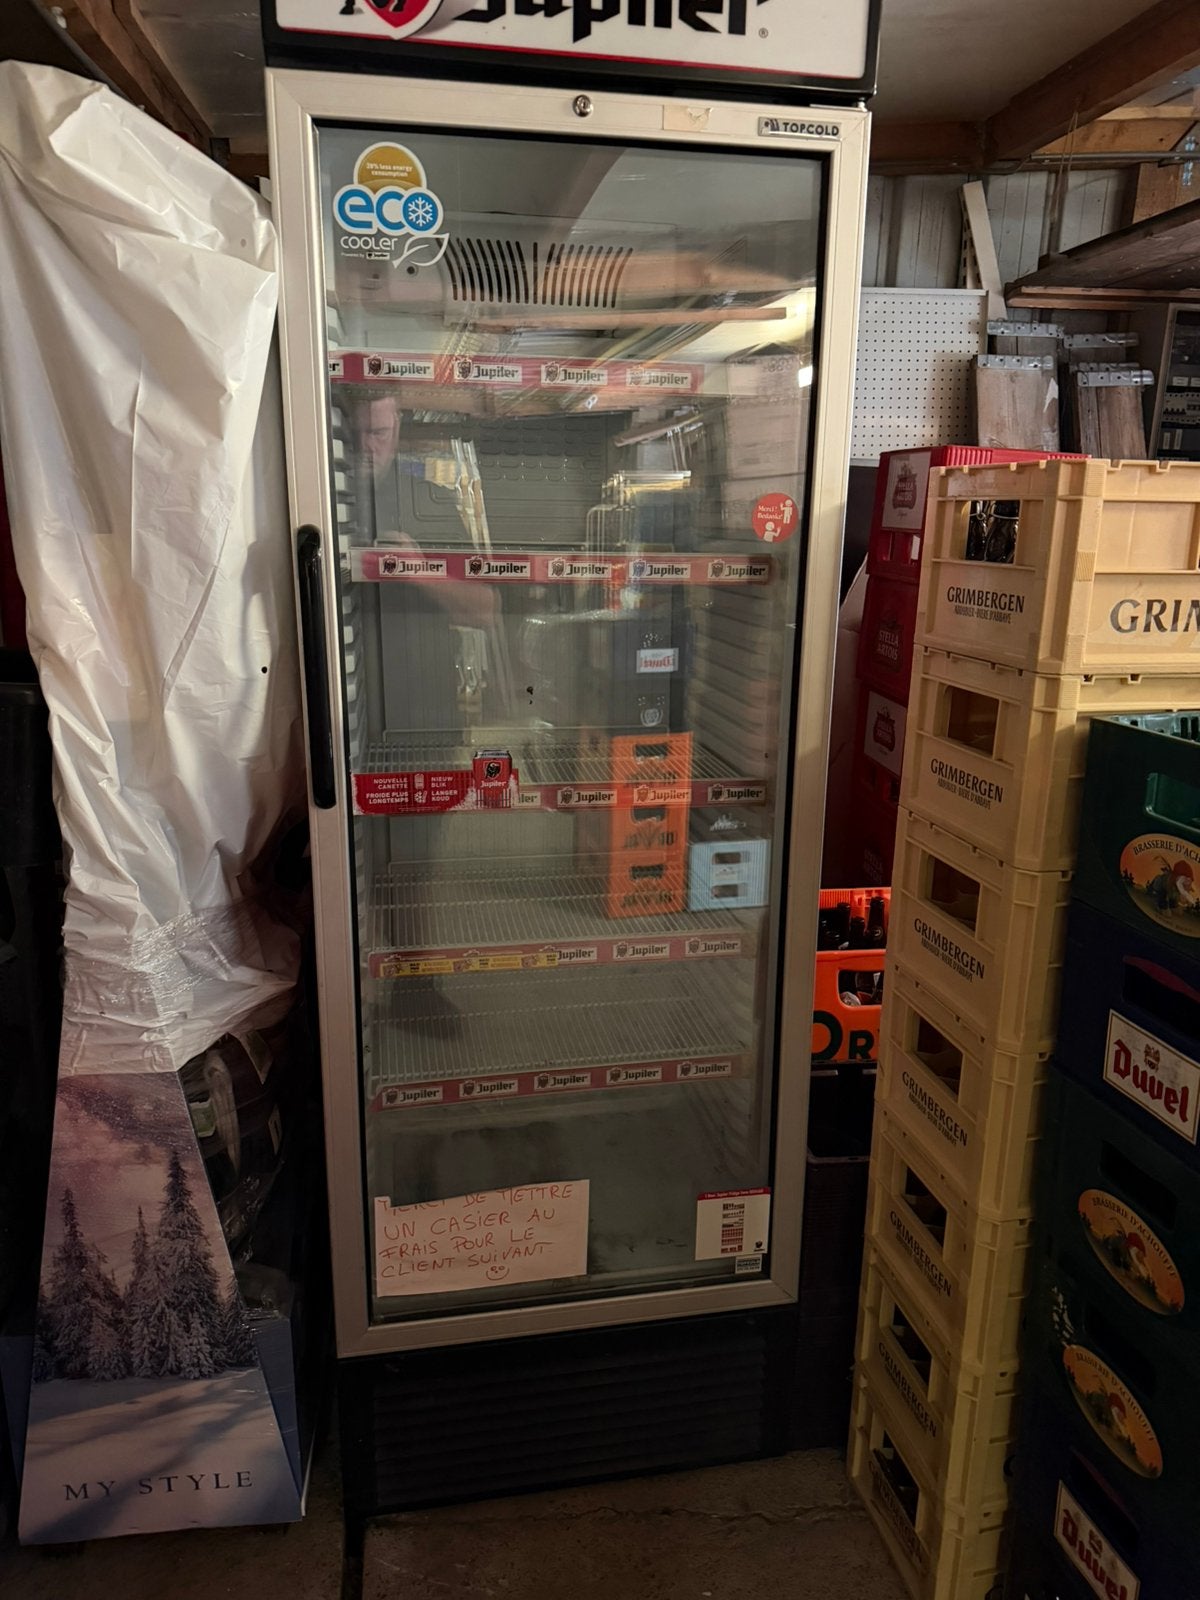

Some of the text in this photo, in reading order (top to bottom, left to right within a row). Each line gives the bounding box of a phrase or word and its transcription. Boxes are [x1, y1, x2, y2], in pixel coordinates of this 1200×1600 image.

[783, 122, 839, 136] TOPCOLD
[338, 189, 439, 231] eco
[385, 363, 430, 377] Jupiler
[474, 366, 519, 379] Jupiler
[560, 369, 604, 382] Jupiler
[399, 561, 443, 575] Jupiler
[485, 561, 528, 575] Jupiler
[566, 563, 608, 576] Jupiler
[646, 564, 688, 577] Jupiler
[726, 565, 766, 578] Jupiler
[947, 586, 1025, 613] GRIMBERGEN
[480, 780, 507, 789] Jupiler
[931, 758, 1003, 803] GRIMBERGEN
[576, 791, 614, 803] Jupiler
[651, 790, 690, 801] Jupiler
[727, 788, 763, 799] Jupiler
[1133, 840, 1174, 856] BRASSERIE
[557, 948, 594, 960] Jupiler
[629, 944, 666, 957] Jupiler
[702, 941, 739, 954] Jupiler
[914, 918, 985, 979] GRIMBERGEN
[622, 1069, 659, 1082] Jupiler
[692, 1063, 729, 1076] Jupiler
[476, 1080, 515, 1094] Jupiler
[551, 1074, 588, 1087] Jupiler
[1113, 1038, 1189, 1123] Duvel
[399, 1087, 440, 1102] Jupiler
[902, 1072, 967, 1146] GRIMBERGEN
[1092, 1197, 1128, 1218] BRASSERIE
[384, 1222, 415, 1241] UN
[528, 1208, 555, 1222] AU
[450, 1232, 495, 1254] POUR
[510, 1227, 535, 1243] LE
[890, 1211, 951, 1297] GRIMBERGEN
[380, 1257, 456, 1279] CLIENT
[63, 1470, 253, 1501] MY STYLE
